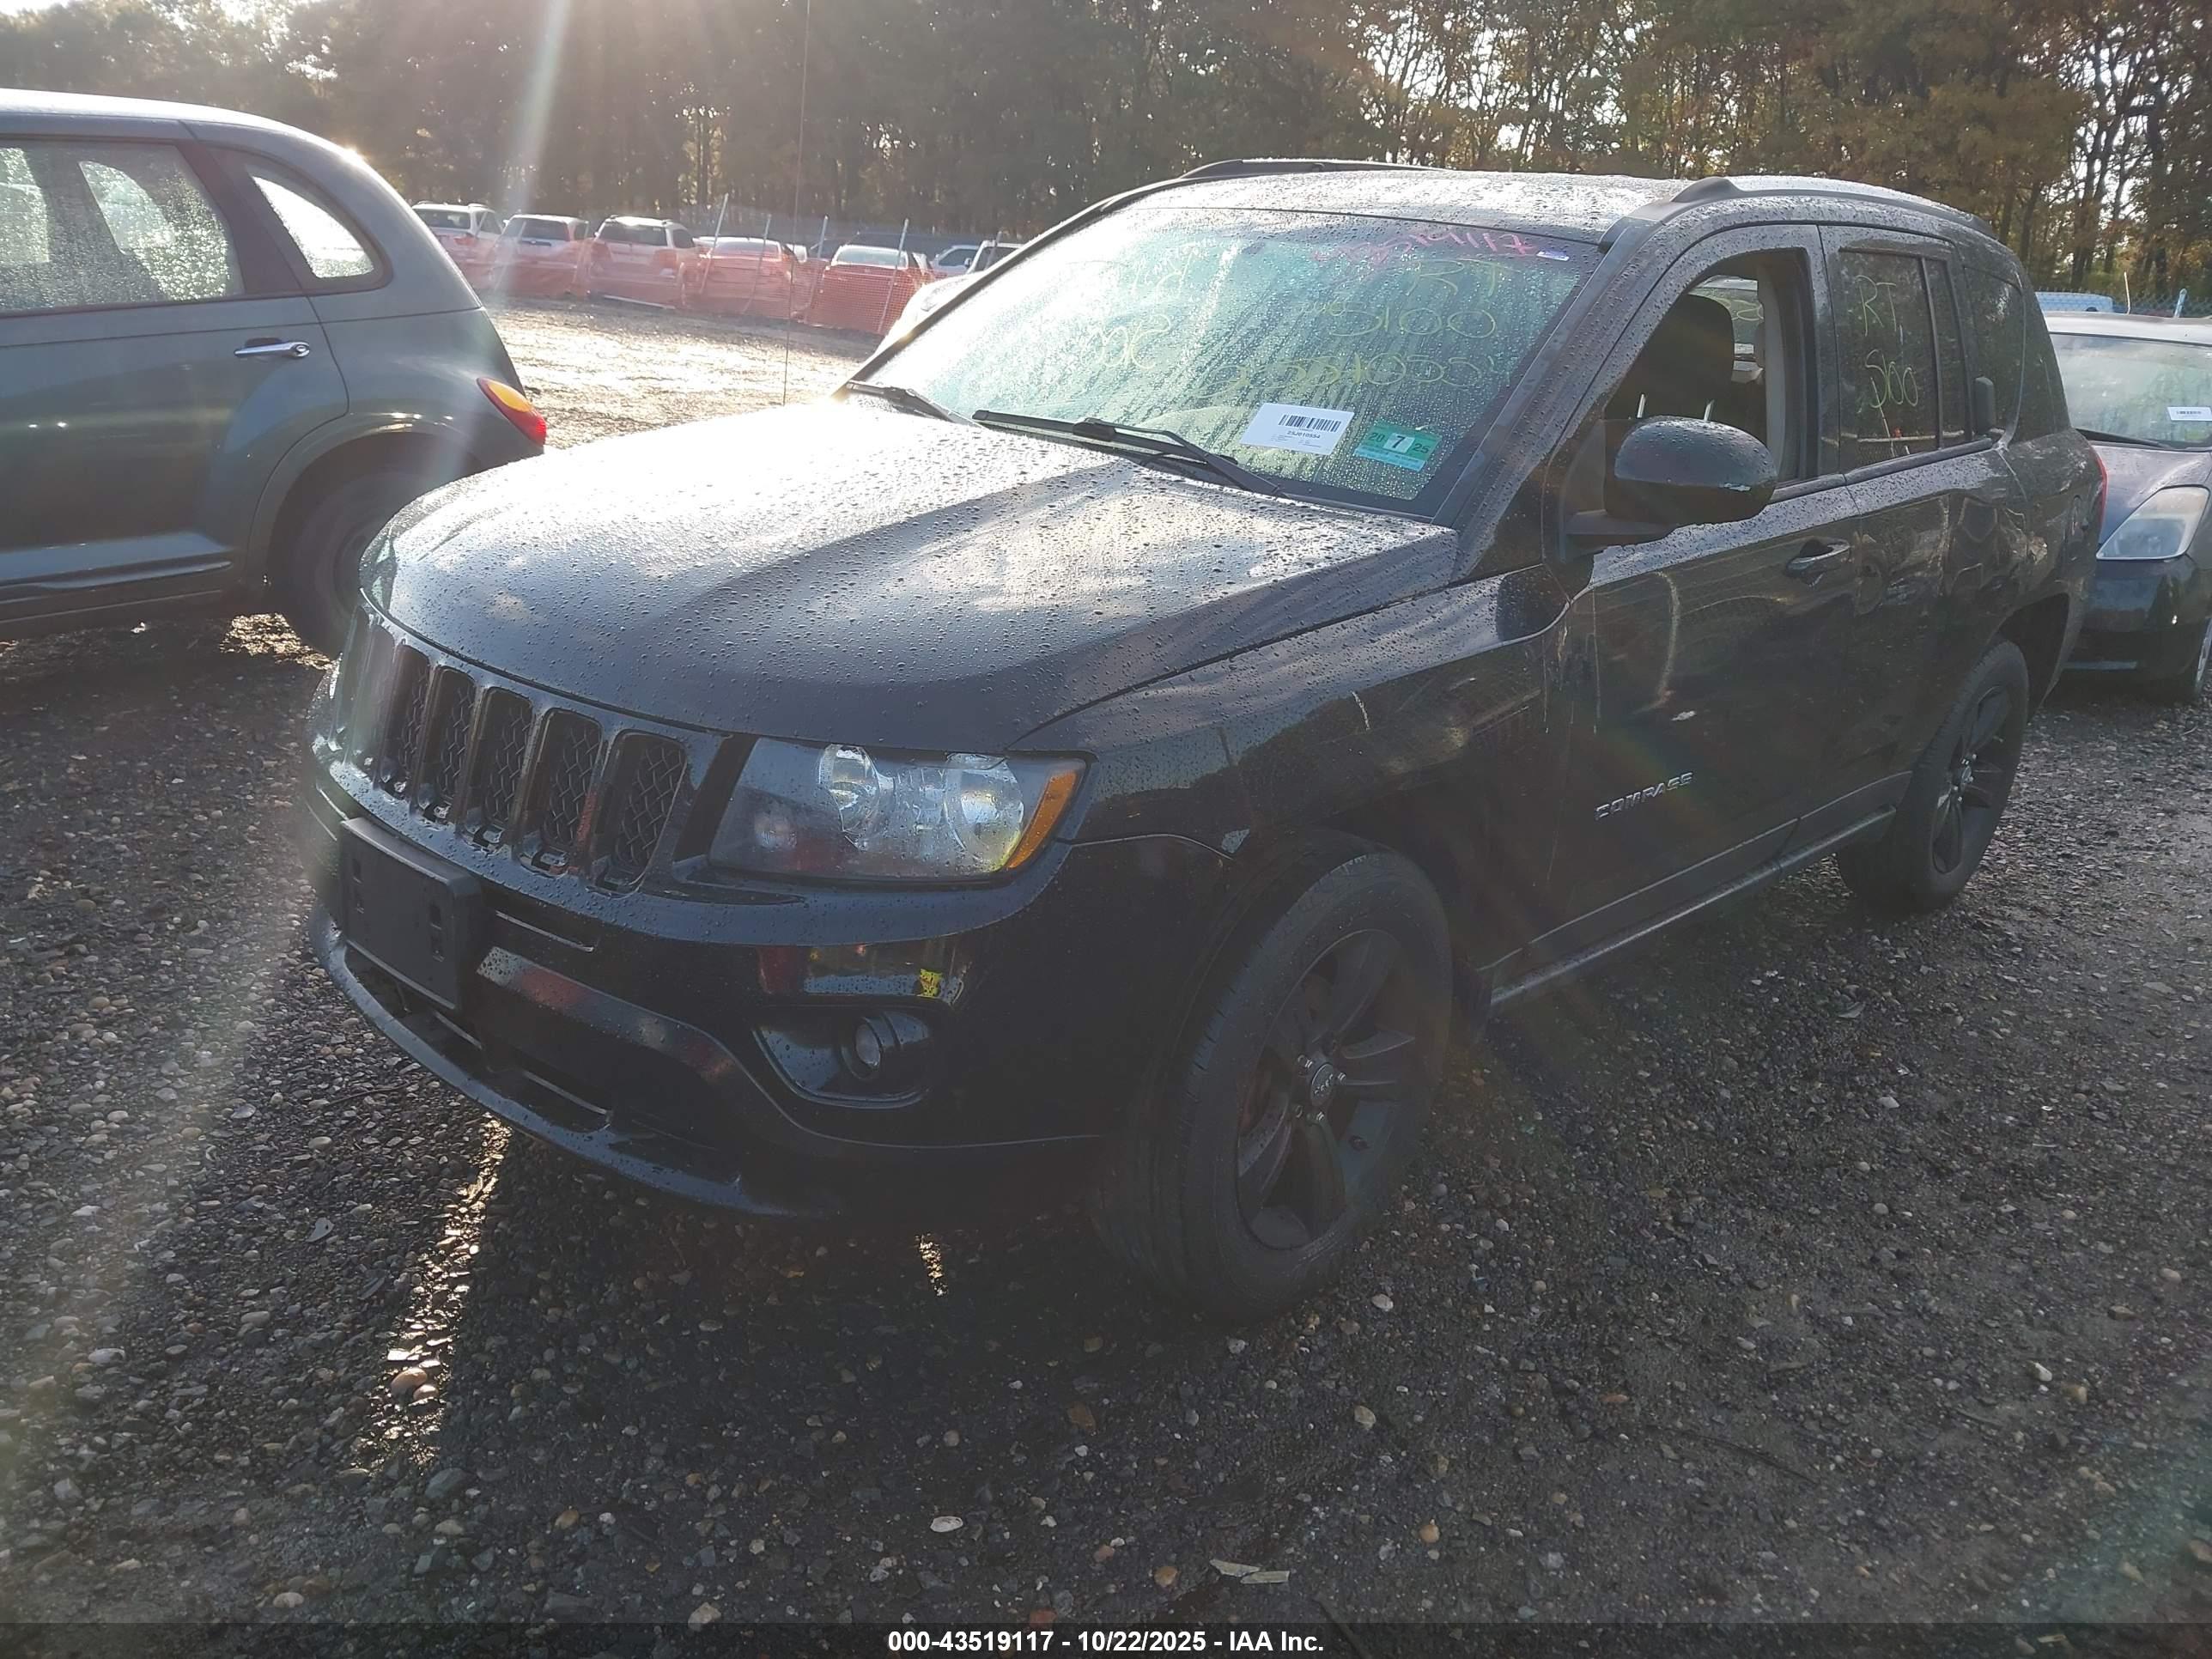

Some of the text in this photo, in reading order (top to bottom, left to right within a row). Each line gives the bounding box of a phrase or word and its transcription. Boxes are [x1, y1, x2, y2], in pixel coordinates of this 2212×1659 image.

[1855, 274, 1897, 337] RT
[1368, 432, 1431, 453] 20 7 25
[1595, 772, 1693, 821] COMPASS
